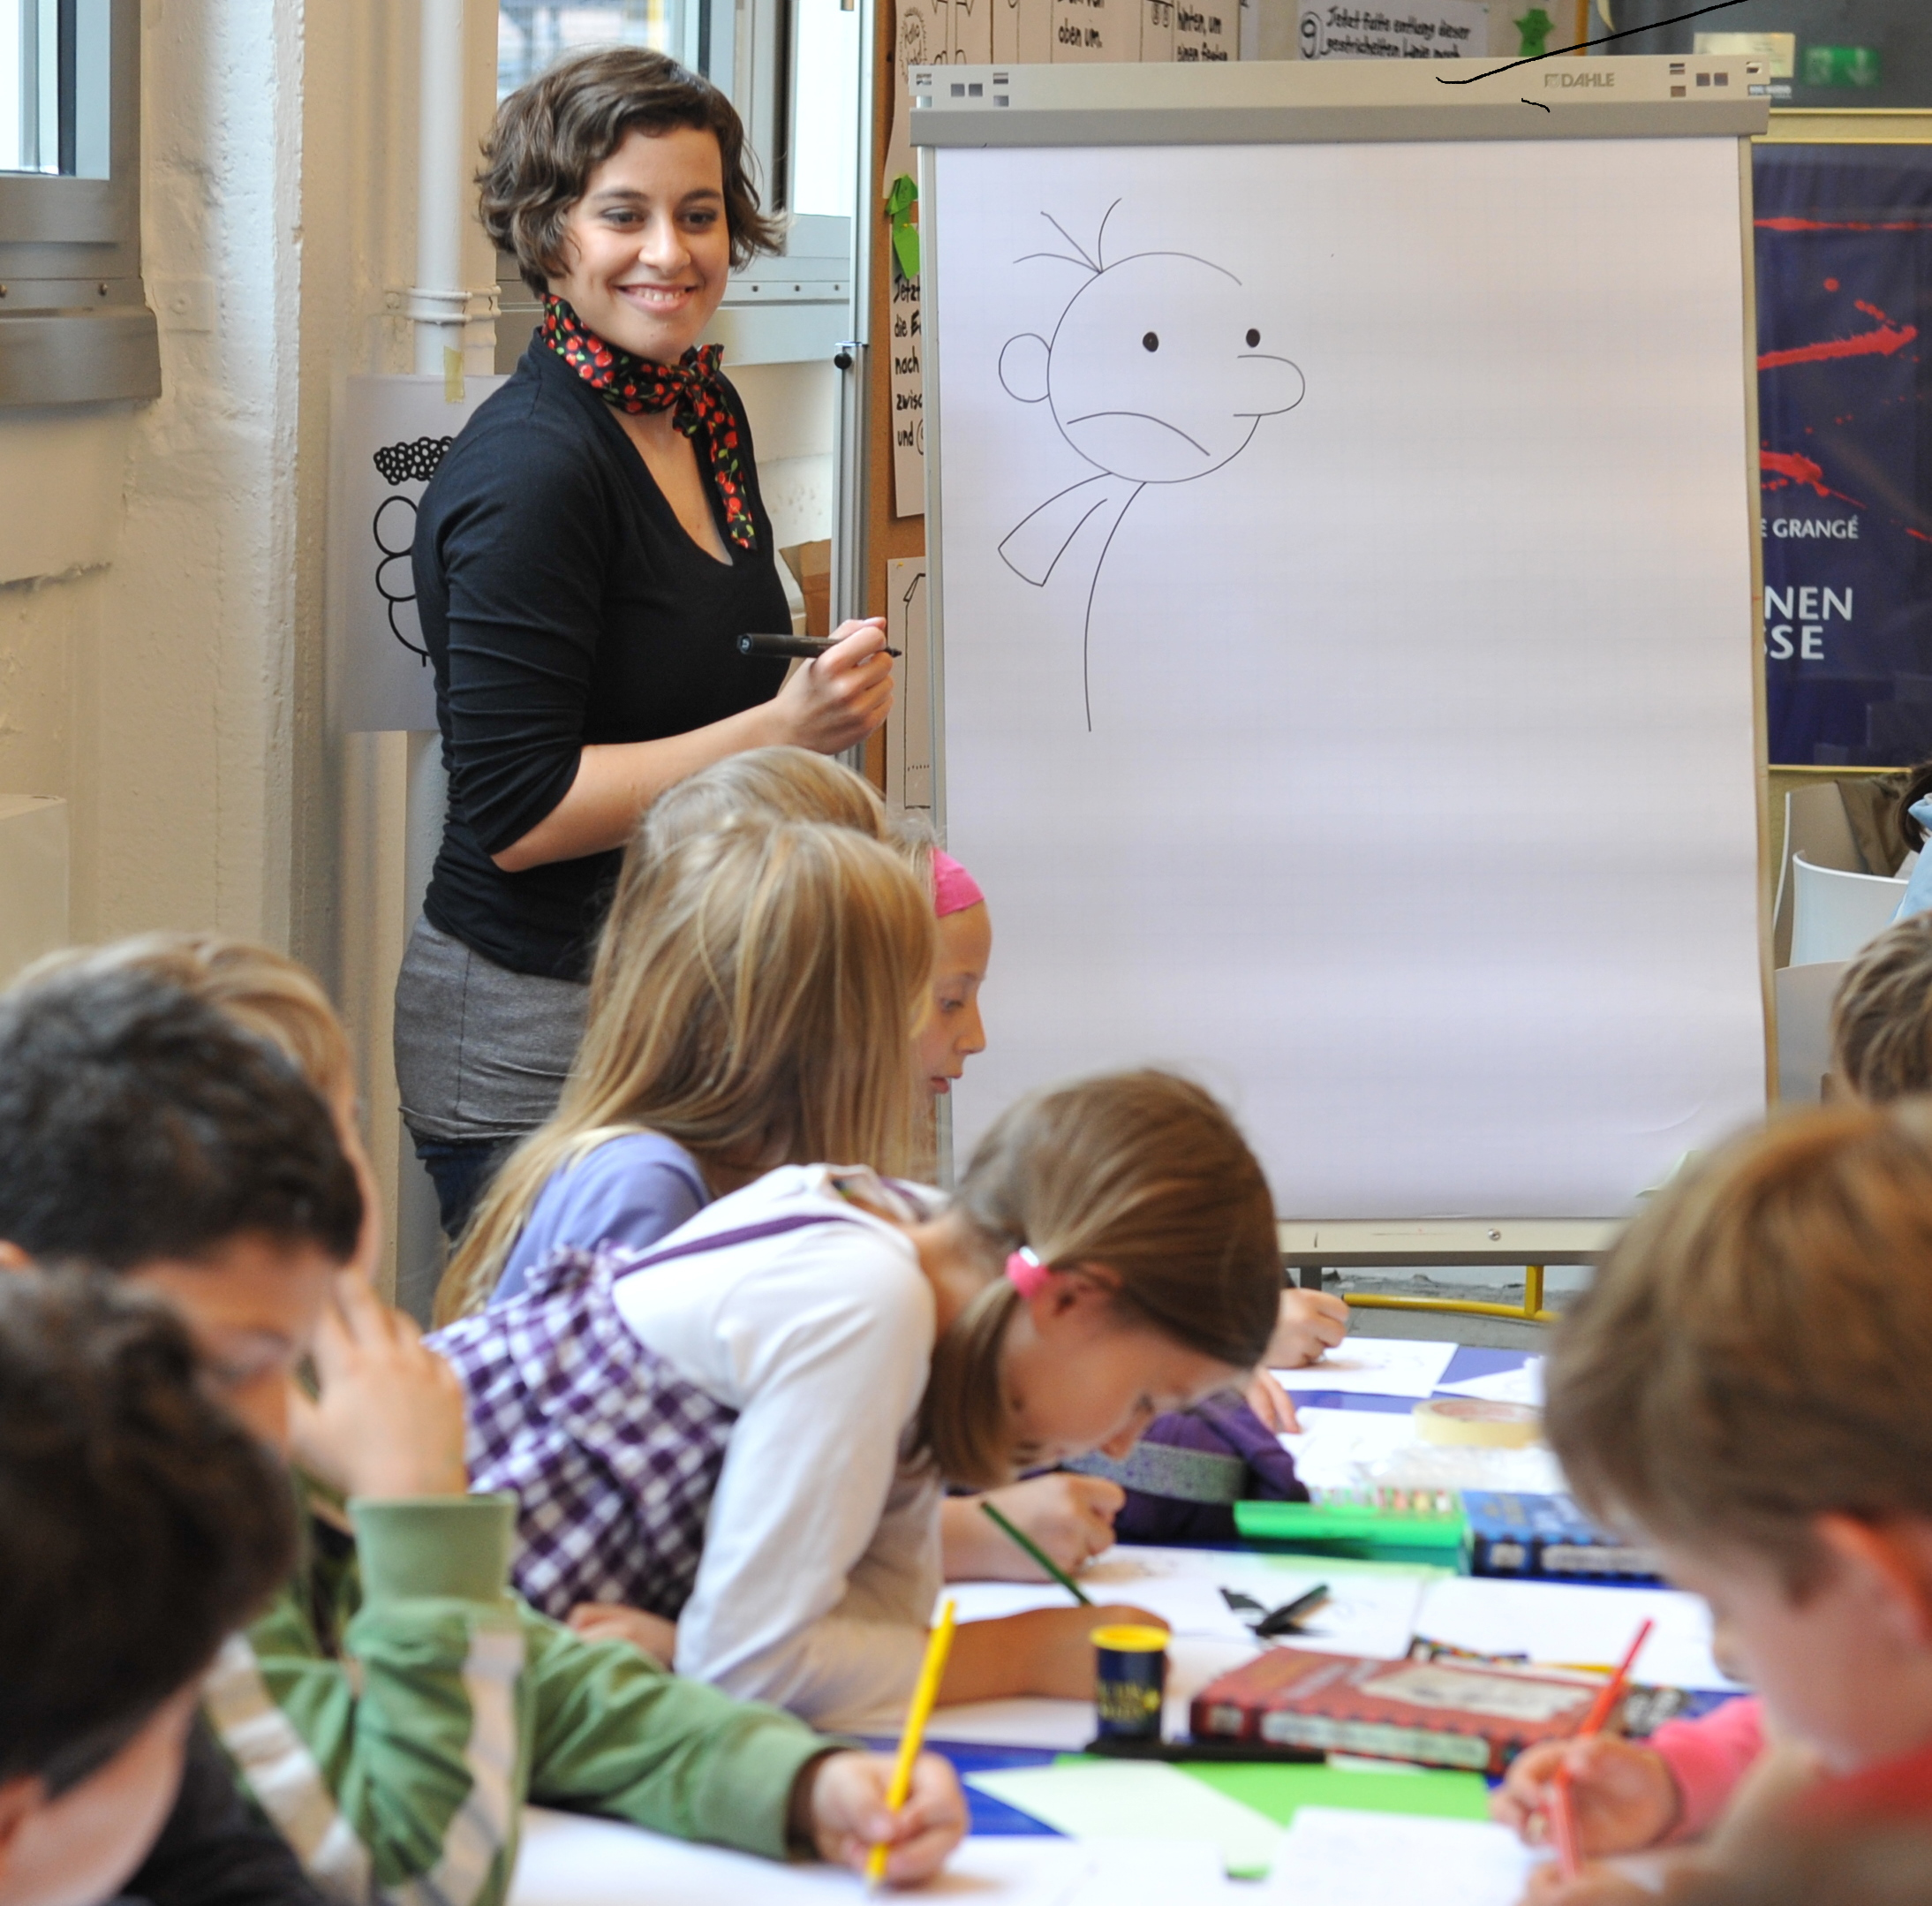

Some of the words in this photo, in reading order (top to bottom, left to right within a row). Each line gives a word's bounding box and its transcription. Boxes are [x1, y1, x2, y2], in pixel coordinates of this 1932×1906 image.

[1326, 6, 1361, 30] Jetzt
[1058, 18, 1082, 48] oben
[1560, 72, 1615, 87] DAHLE
[894, 314, 909, 338] die
[910, 309, 921, 338] E
[897, 420, 914, 447] und
[1772, 514, 1859, 539] GRANGÉ
